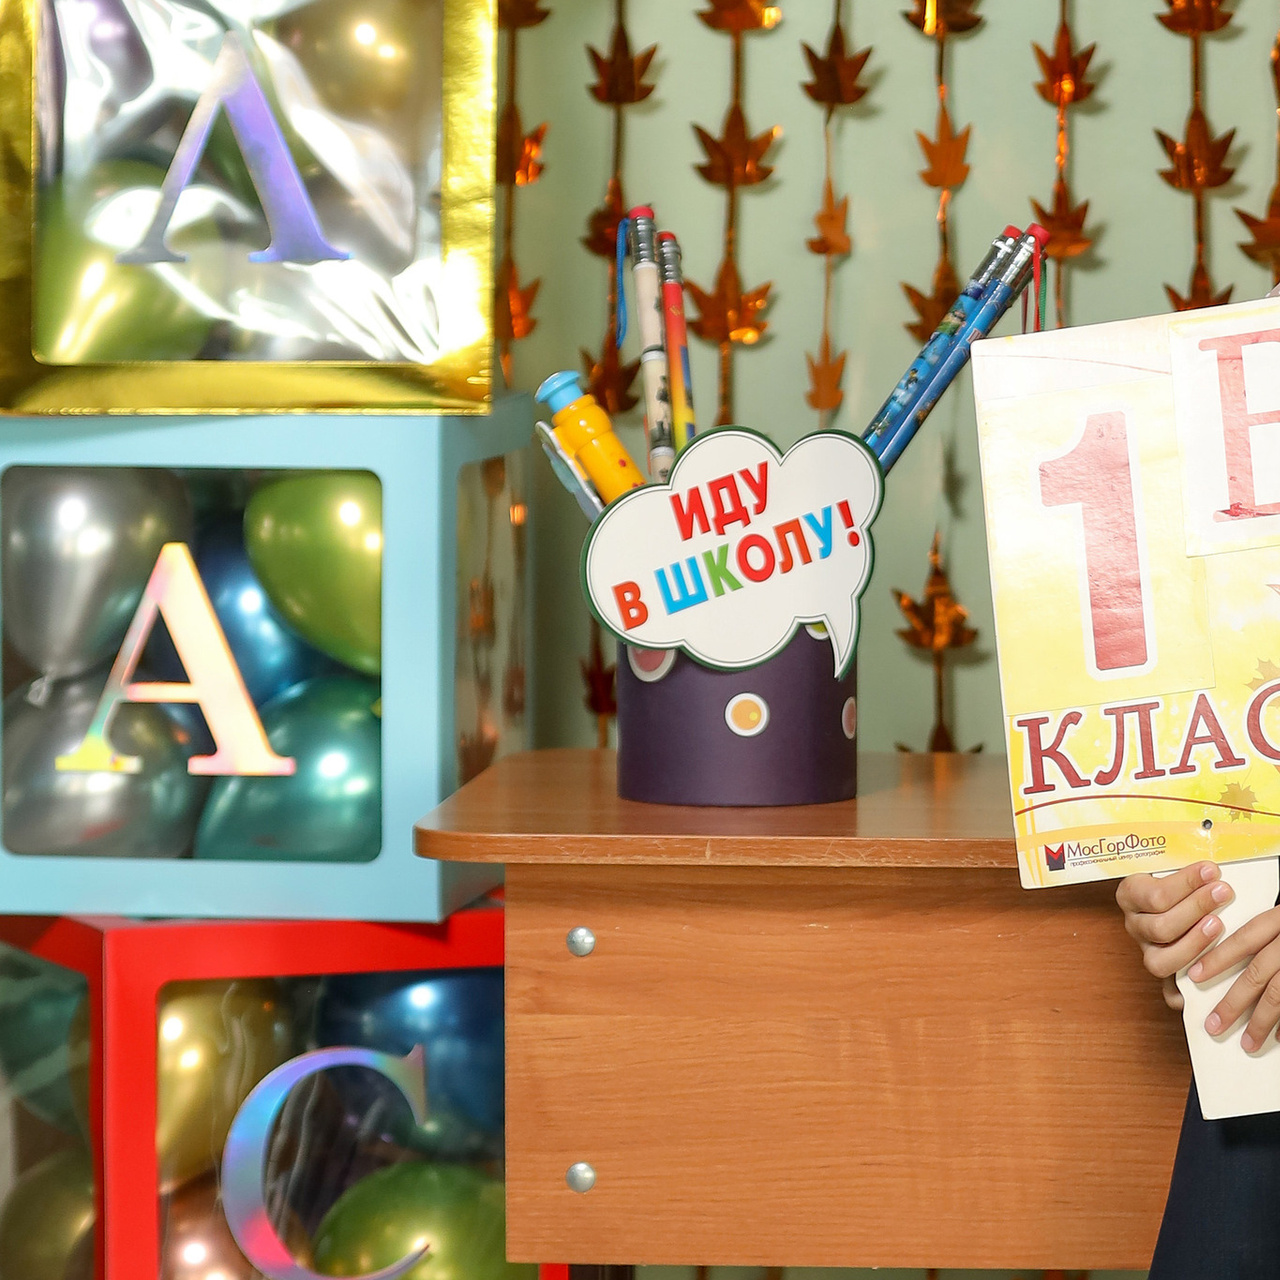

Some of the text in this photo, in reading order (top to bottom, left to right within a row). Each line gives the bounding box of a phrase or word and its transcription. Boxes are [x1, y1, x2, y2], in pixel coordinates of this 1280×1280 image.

[653, 499, 861, 616] ШКОЛУ!
[669, 460, 769, 542] ИДУ
[1039, 411, 1146, 672] 1
[55, 542, 296, 776] А
[1067, 833, 1167, 858] МосГорФото
